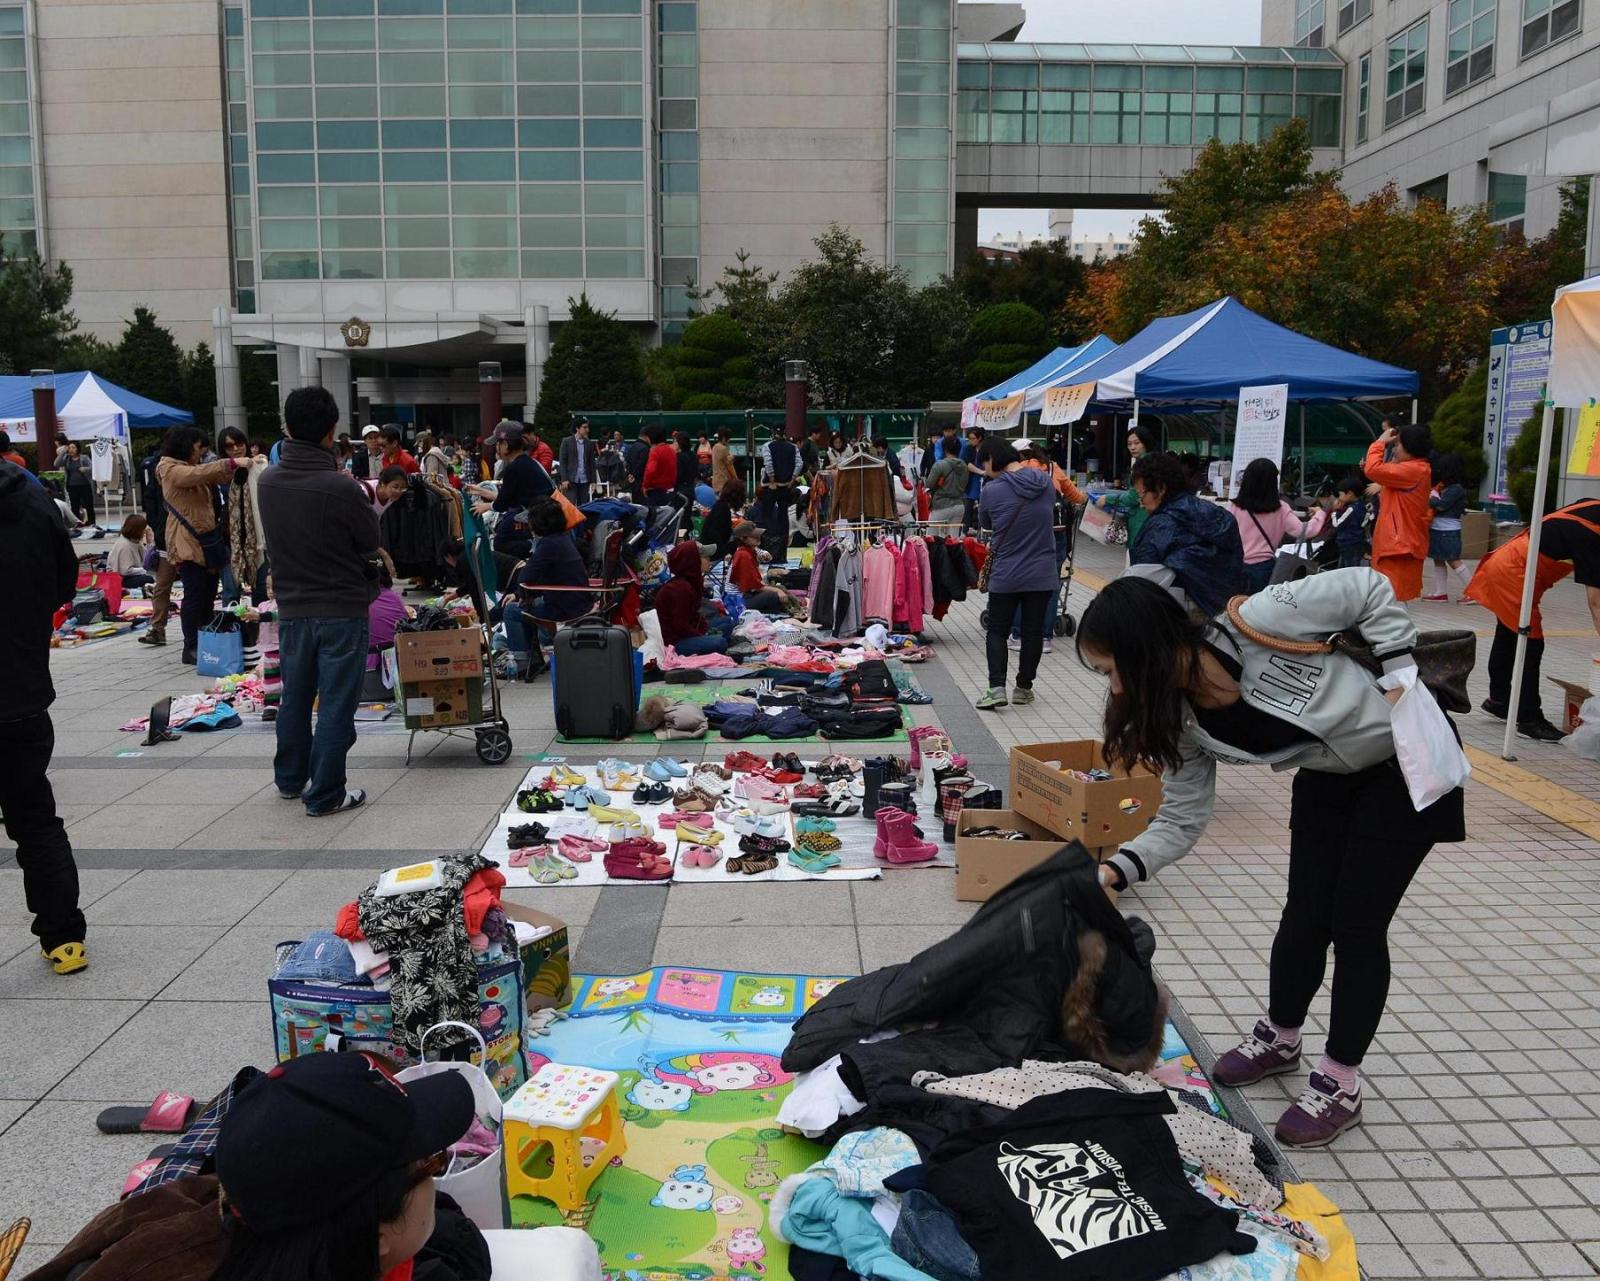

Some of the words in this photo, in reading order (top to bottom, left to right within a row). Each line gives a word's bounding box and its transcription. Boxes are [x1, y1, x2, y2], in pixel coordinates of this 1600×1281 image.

[532, 930, 566, 950] MANNA
[488, 1033, 513, 1050] STORE
[1131, 1196, 1167, 1231] MUSIC
